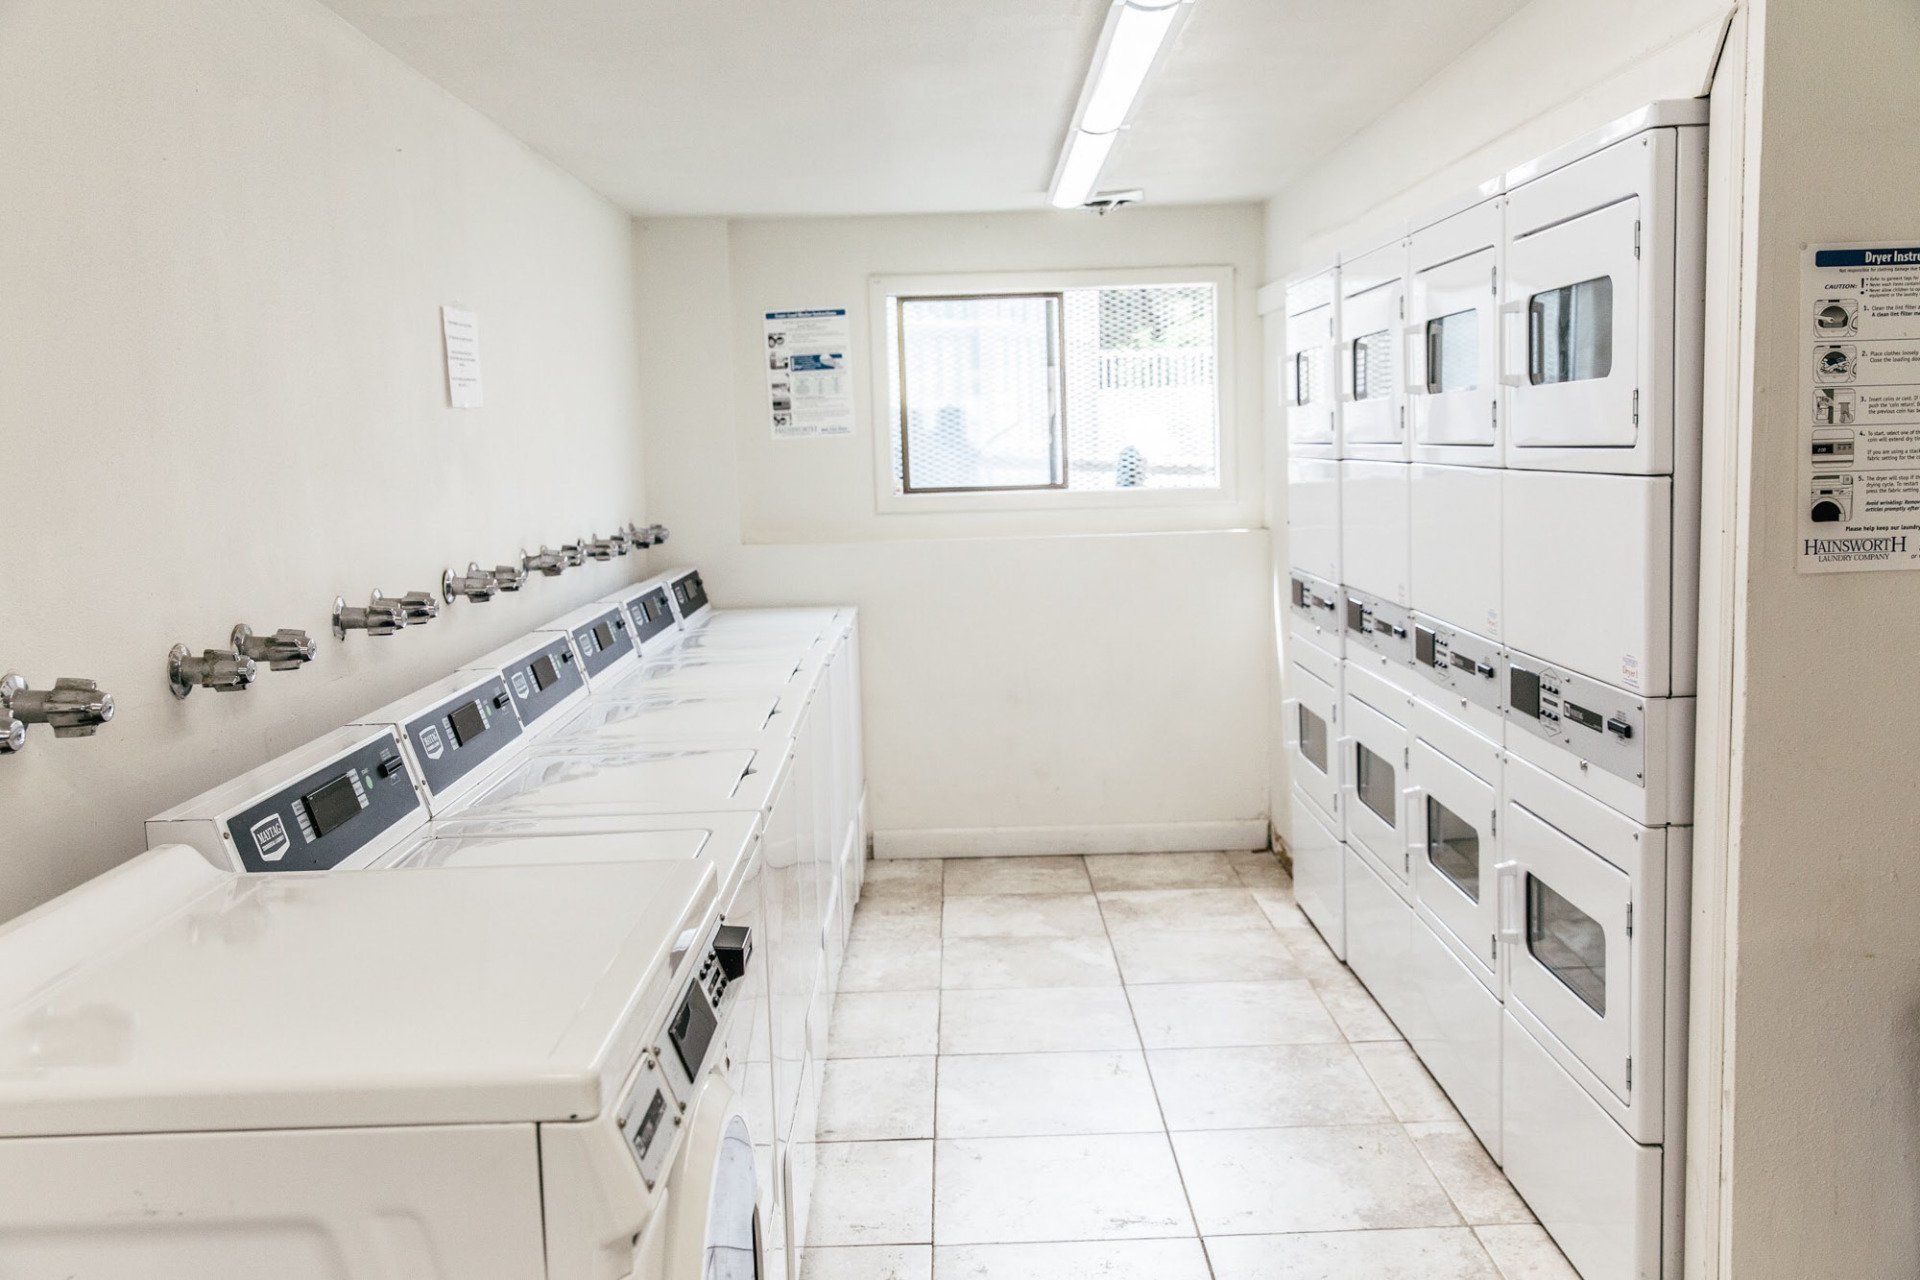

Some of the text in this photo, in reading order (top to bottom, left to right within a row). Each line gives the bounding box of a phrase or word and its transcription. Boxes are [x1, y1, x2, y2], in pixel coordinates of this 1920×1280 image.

[1865, 251, 1892, 264] Dryer
[1804, 536, 1907, 556] HAINSWORTH
[1818, 553, 1890, 562] LAUNDRY COMPANY
[256, 822, 283, 845] MAYTAG
